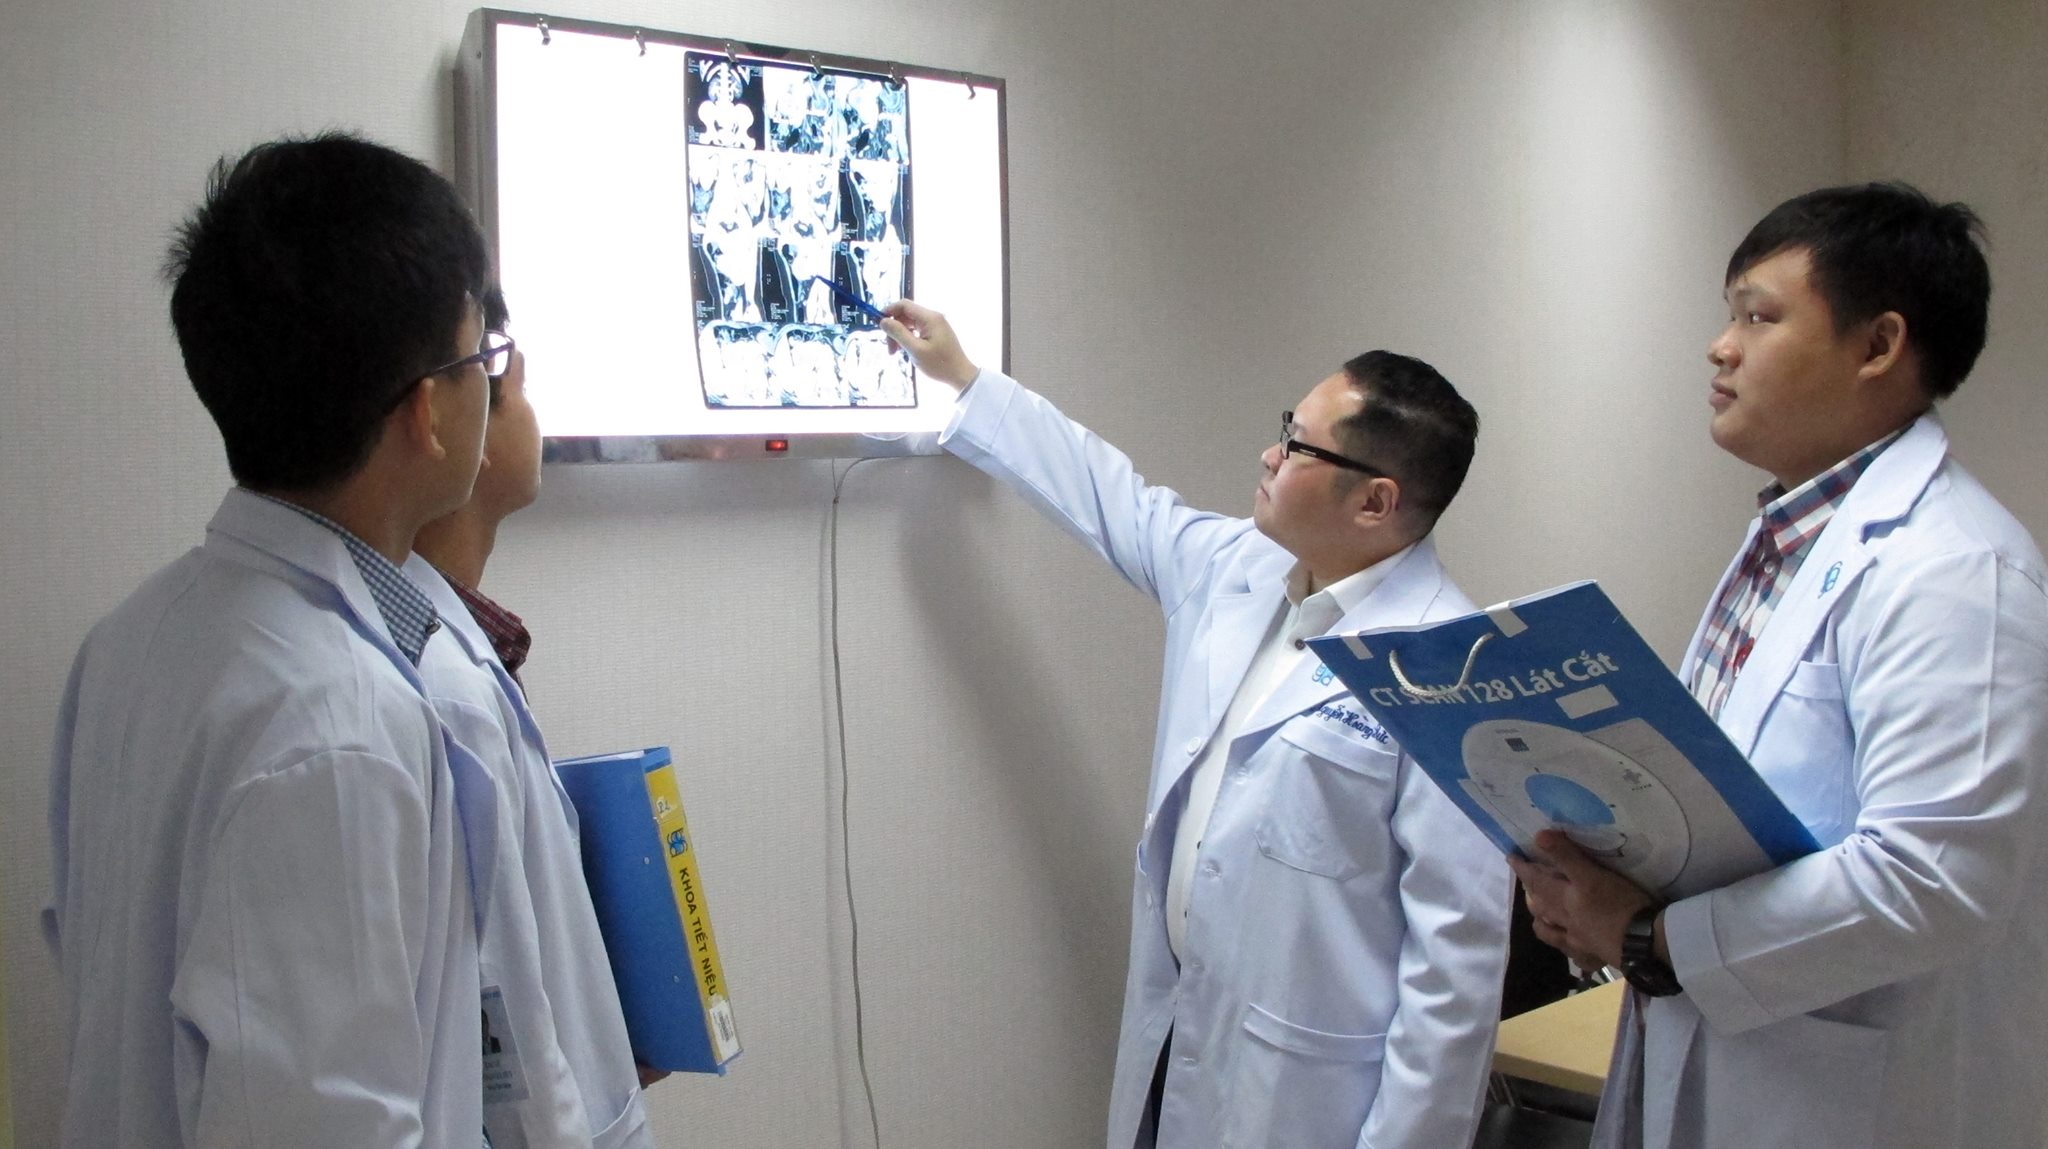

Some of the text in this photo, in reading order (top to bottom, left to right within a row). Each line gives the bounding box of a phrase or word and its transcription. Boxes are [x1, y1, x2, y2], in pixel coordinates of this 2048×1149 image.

[1369, 687, 1403, 707] CT
[1462, 678, 1515, 704] 128
[1510, 669, 1565, 697] Lát
[1562, 649, 1620, 682] Cắt
[679, 867, 718, 997] KHOA TIẾT NIỆU
